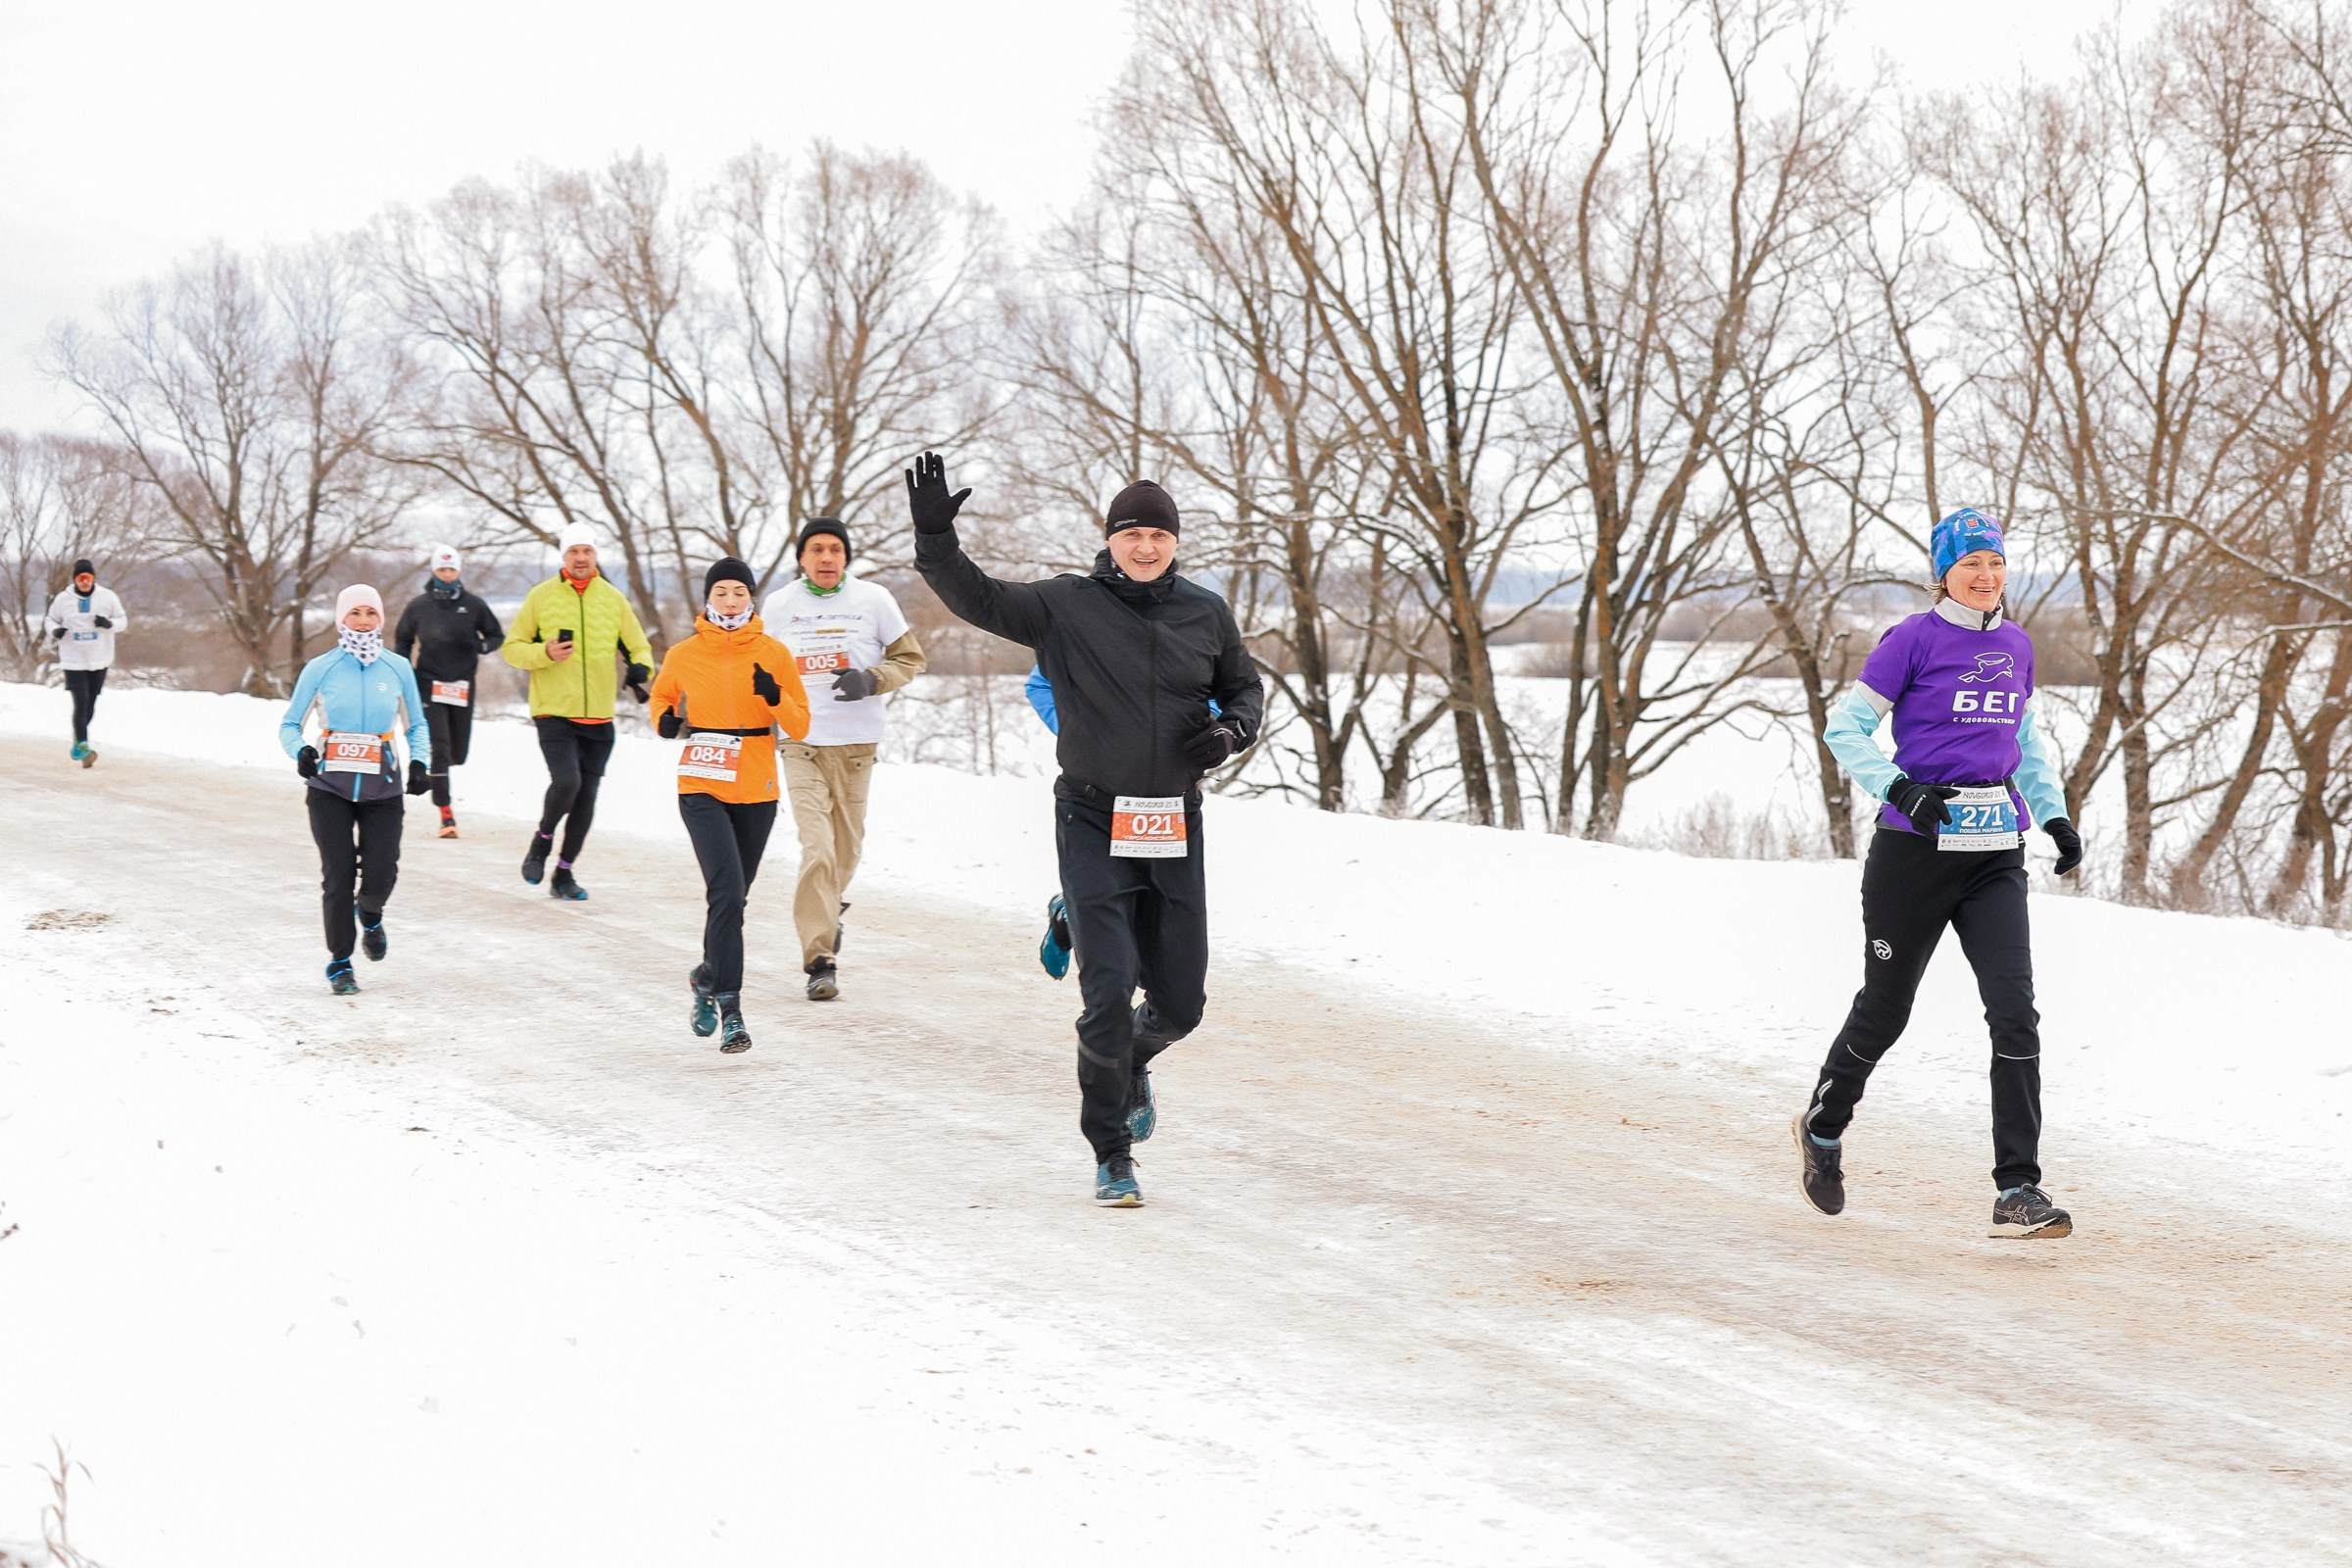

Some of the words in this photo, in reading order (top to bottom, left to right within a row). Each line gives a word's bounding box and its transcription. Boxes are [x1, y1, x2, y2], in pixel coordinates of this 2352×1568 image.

[805, 654, 838, 670] 005
[1952, 690, 2020, 713] БЕГ
[337, 743, 369, 758] 097
[689, 746, 726, 764] 084
[1132, 814, 1174, 835] 021
[1960, 805, 2003, 827] 271
